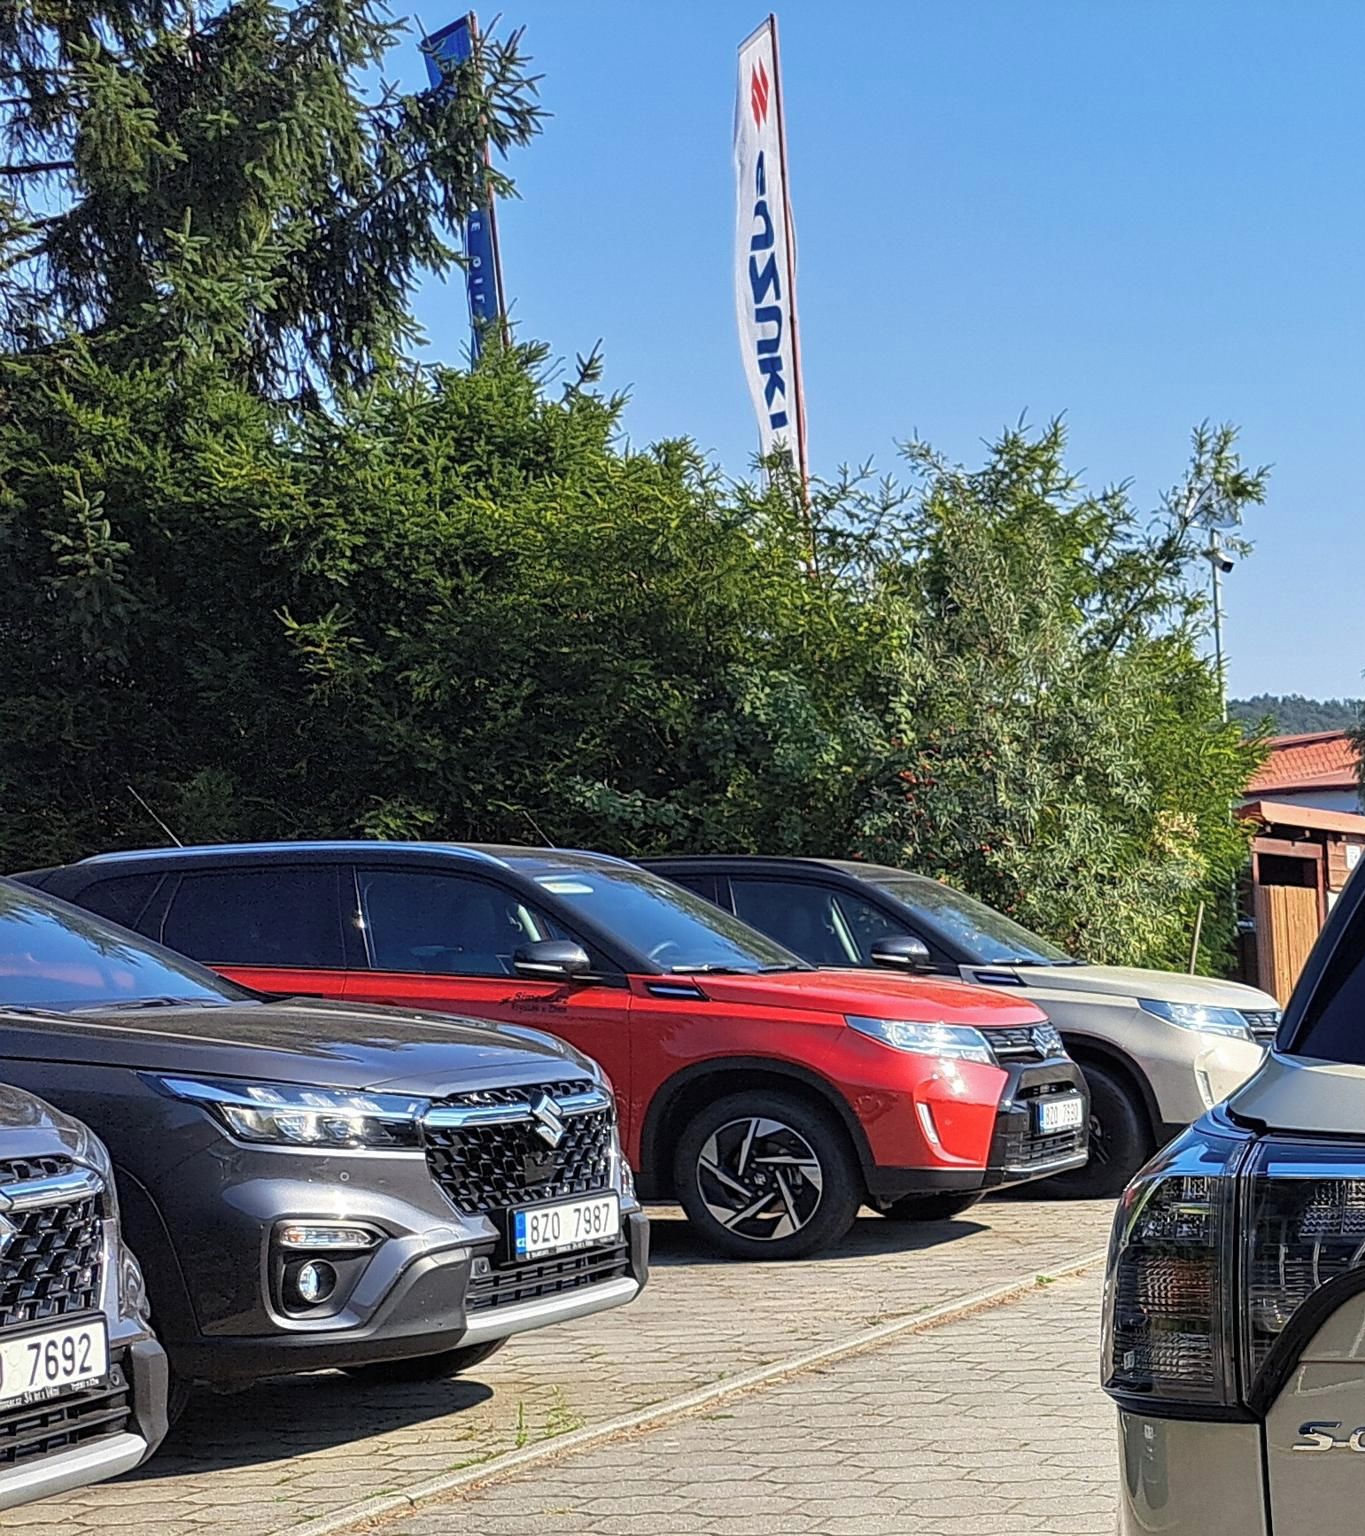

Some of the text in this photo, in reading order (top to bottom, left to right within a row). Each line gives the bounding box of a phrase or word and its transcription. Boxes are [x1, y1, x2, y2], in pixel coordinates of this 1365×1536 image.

[530, 1202, 610, 1245] 8Z0 7987
[27, 1332, 92, 1386] 7692
